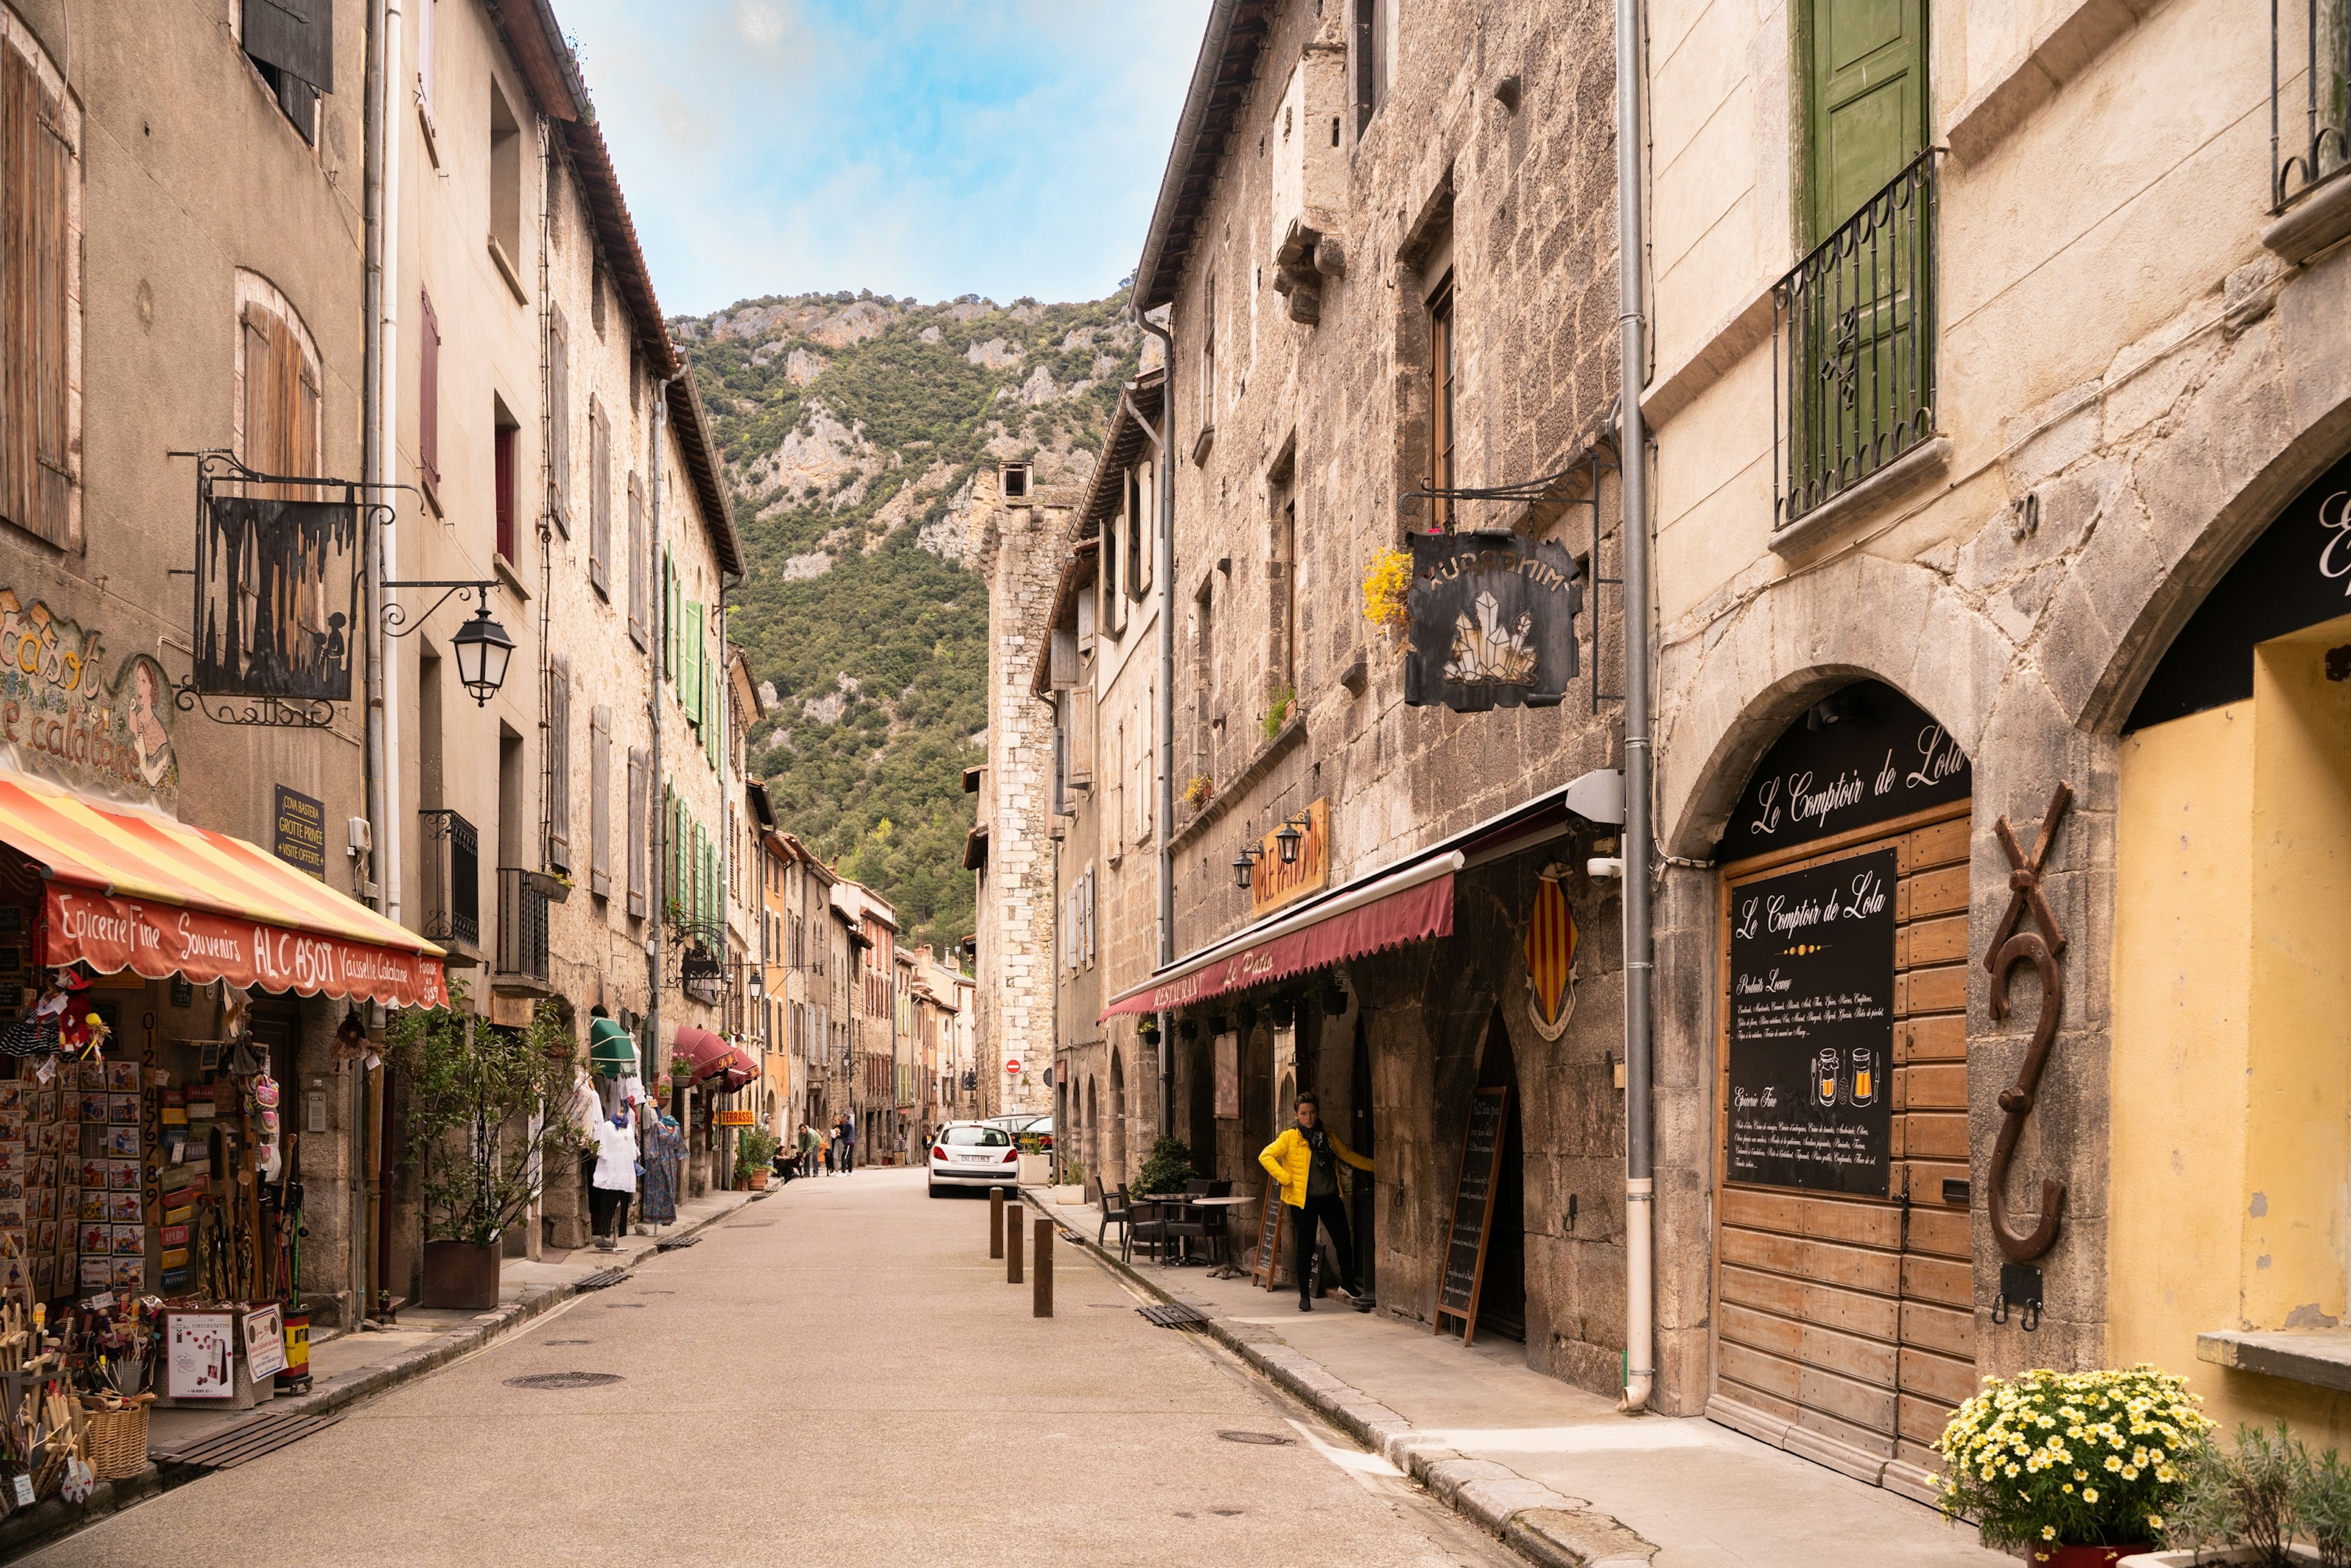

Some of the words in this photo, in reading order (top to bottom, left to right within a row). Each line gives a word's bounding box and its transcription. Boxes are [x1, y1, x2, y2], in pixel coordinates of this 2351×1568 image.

[31, 705, 141, 782] catalane
[1751, 776, 1780, 834] Le
[1788, 768, 1864, 828] Comptoir
[1874, 748, 1897, 796] de
[1906, 725, 1965, 789] Lola
[283, 795, 298, 812] COVA
[298, 801, 319, 820] BASTERA
[279, 816, 303, 838] GROTTE
[304, 827, 323, 846] PRIVÉE
[283, 842, 298, 860] VISITE
[299, 848, 320, 866] OFFERTE
[1264, 847, 1274, 901] LE
[1736, 896, 1759, 940] Le
[1767, 895, 1821, 940] Comptoir
[1823, 888, 1840, 923] de
[1843, 870, 1886, 919] Lola
[59, 894, 127, 950] Epicerie
[129, 904, 160, 952] Fine
[178, 912, 241, 962] Souvenirs
[253, 926, 279, 978] AL
[338, 946, 377, 980] Vaisselle
[377, 952, 408, 983] Catalane
[1153, 972, 1205, 1007] RESTAURANT
[1224, 958, 1237, 985] Le
[1242, 950, 1274, 981] Patio
[722, 1111, 754, 1123] TERRASSE
[1734, 1086, 1758, 1112] Epicerie
[1760, 1086, 1777, 1108] Fine
[187, 1145, 208, 1157] PASTIS
